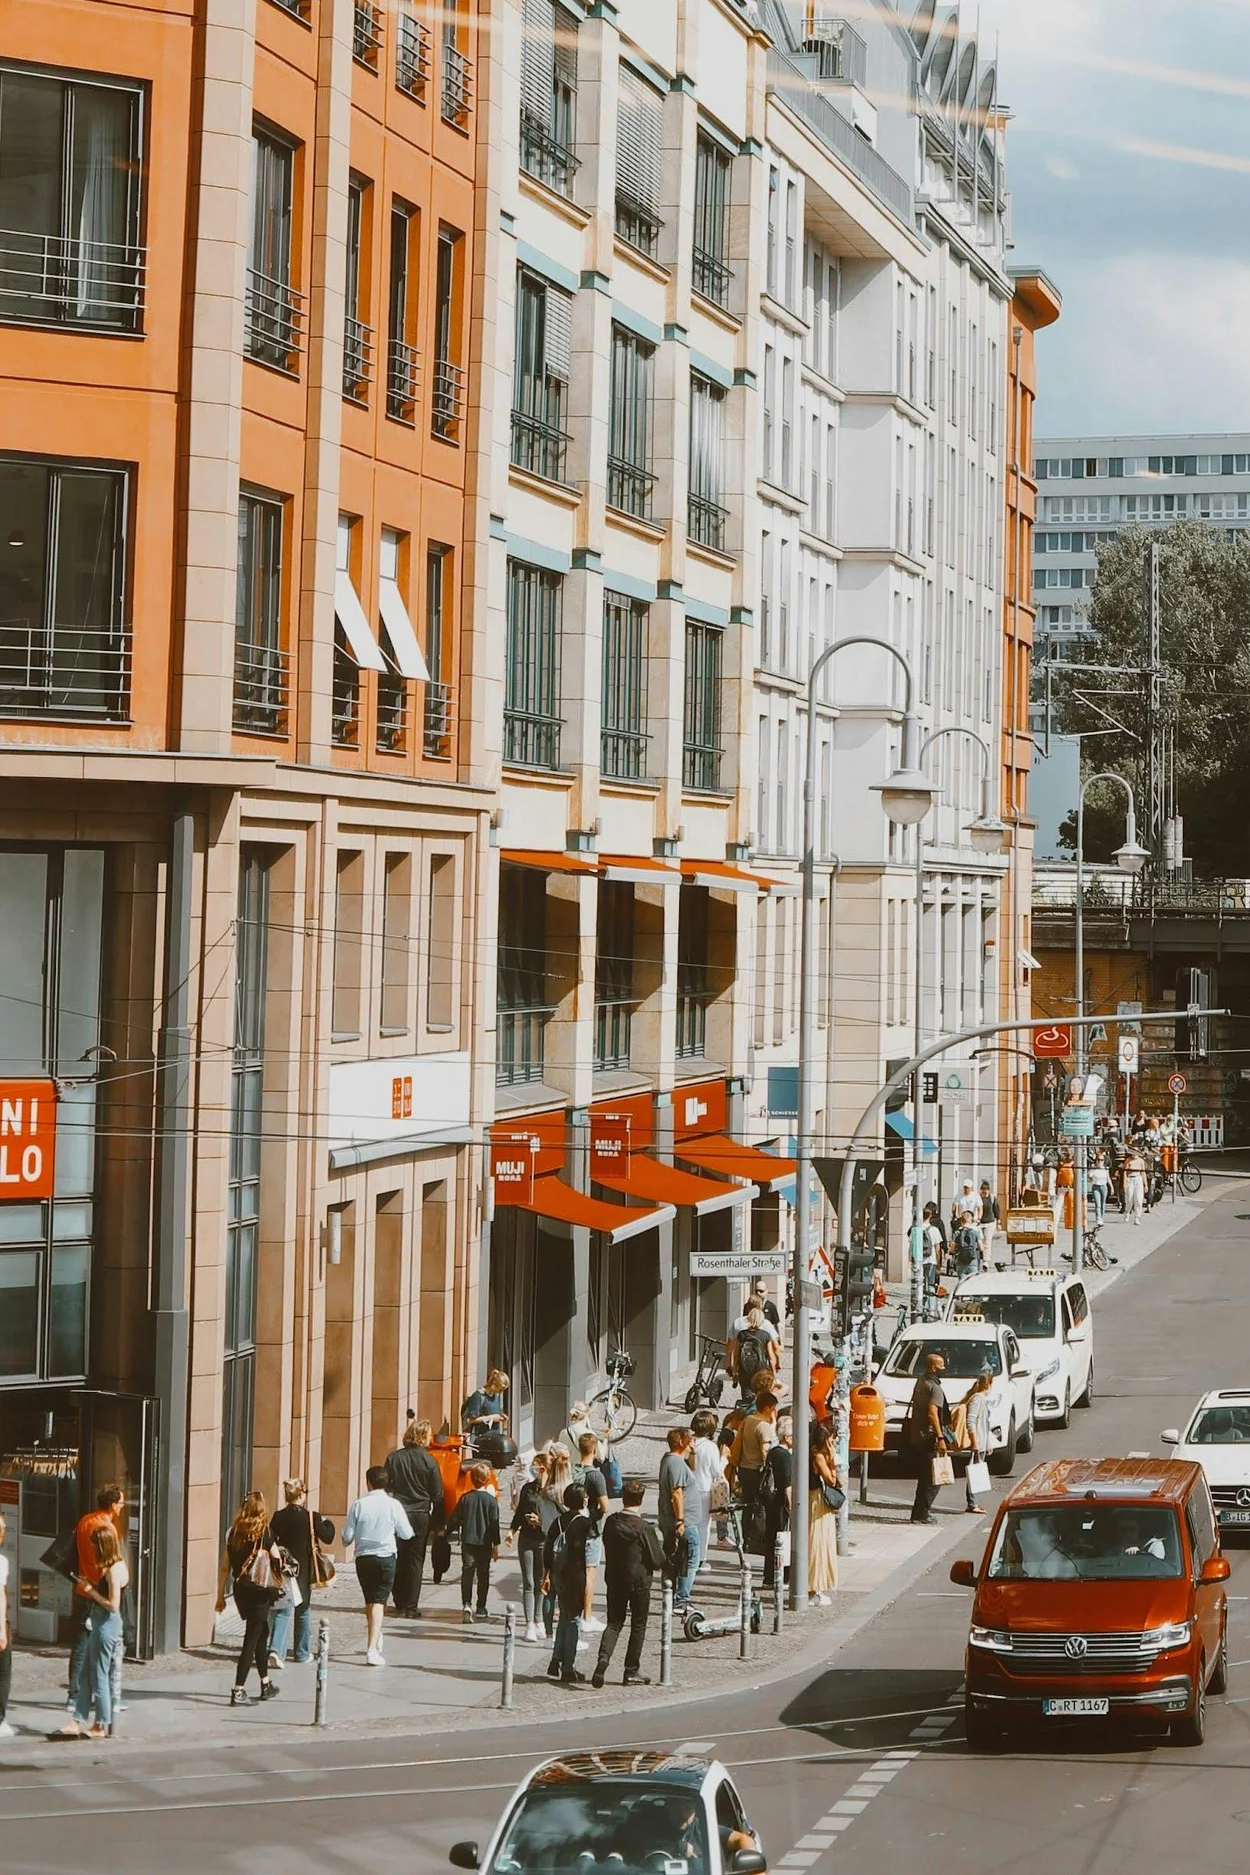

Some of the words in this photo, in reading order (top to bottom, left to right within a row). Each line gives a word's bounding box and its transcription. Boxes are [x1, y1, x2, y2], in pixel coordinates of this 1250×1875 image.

[595, 1139, 621, 1151] MUJI
[496, 1161, 525, 1175] MUJI
[697, 1257, 751, 1269] Rosenthaler
[1049, 1700, 1057, 1711] C
[1063, 1700, 1078, 1711] RT
[1080, 1700, 1107, 1711] 1167
